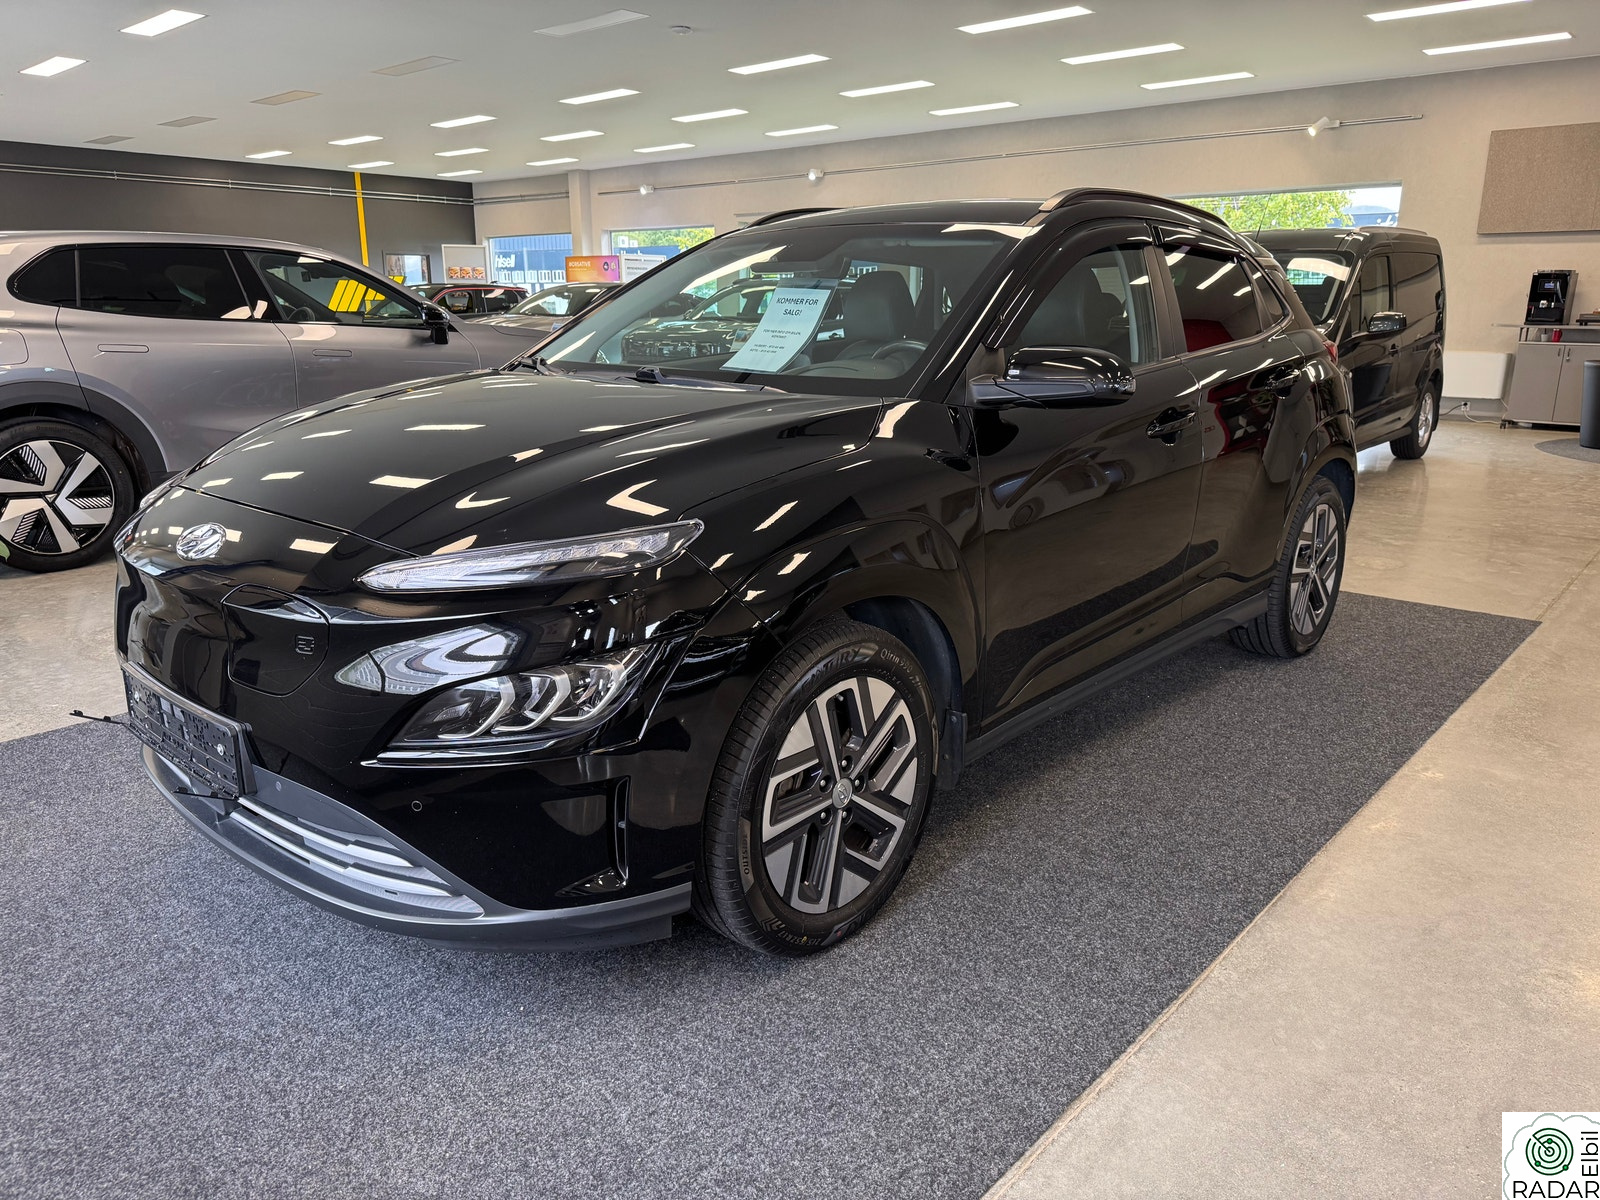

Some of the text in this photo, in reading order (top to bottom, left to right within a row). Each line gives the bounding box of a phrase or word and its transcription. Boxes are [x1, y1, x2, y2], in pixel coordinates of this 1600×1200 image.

[776, 297, 819, 306] KOMMER FOR
[783, 308, 802, 316] SALG!
